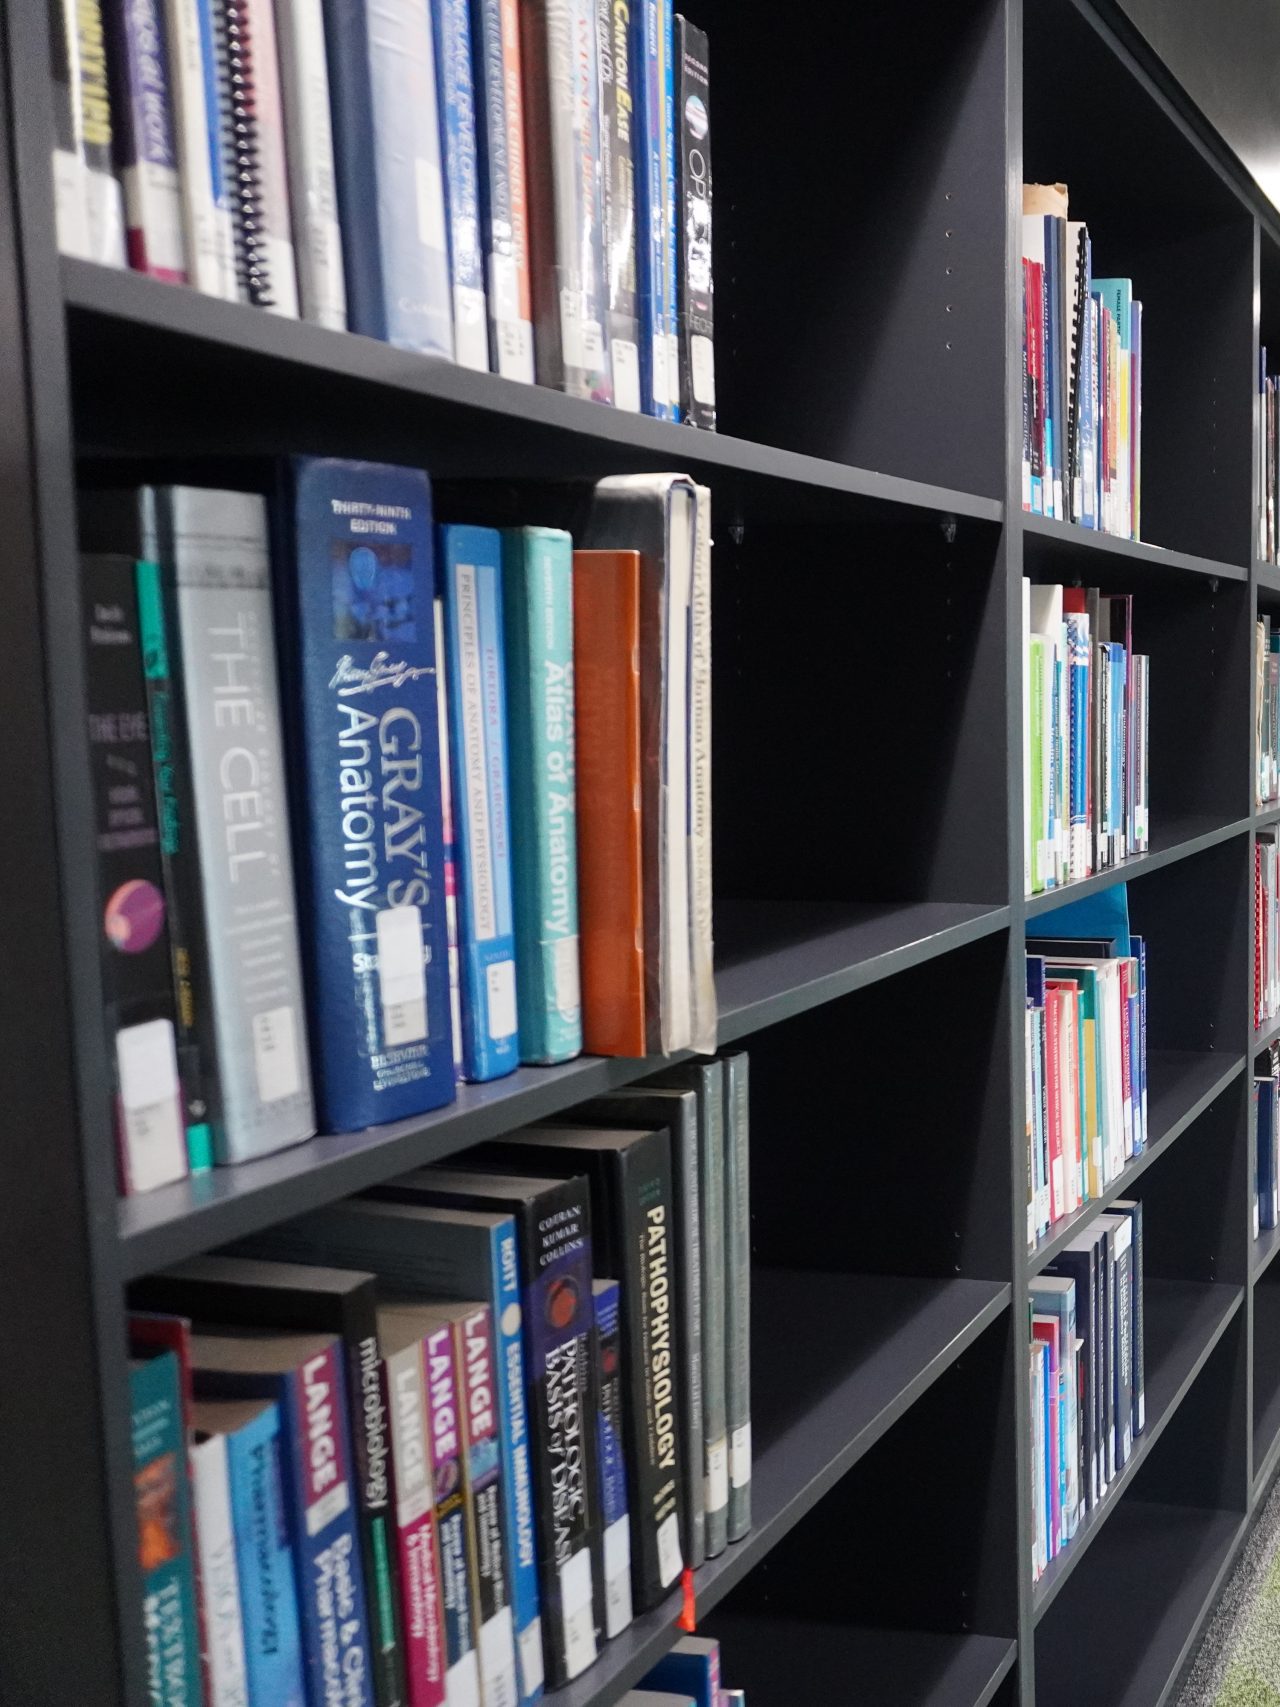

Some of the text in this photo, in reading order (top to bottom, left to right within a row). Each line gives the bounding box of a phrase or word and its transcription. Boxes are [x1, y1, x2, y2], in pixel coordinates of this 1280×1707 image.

[331, 498, 412, 521] THIRTY-NINTH
[350, 518, 397, 536] EDITION
[208, 612, 256, 728] THE
[220, 747, 268, 884] CELL
[334, 703, 380, 909] Anatomy
[378, 706, 430, 908] GRAY'S
[460, 573, 492, 931] PRINCIPLES OF ANATOMY AND PHYSIOLOGY
[544, 660, 579, 934] Atlas of Anatomy
[539, 1205, 582, 1232] COTRAN
[539, 1237, 584, 1266] COLLINS
[542, 1223, 579, 1248] KUMAR
[427, 1328, 456, 1459] LANGE
[464, 1313, 493, 1437] LANGE
[501, 1237, 534, 1568] ROITT ESSENTIAL IMMUNOLOGY
[545, 1346, 564, 1429] BASIS
[645, 1204, 676, 1470] PATHOPHYSIOLOGY
[303, 1354, 338, 1494] LANGE
[359, 1336, 390, 1508] microbiology
[396, 1367, 425, 1489] LANGE
[561, 1337, 586, 1521] PATHOLOGIC
